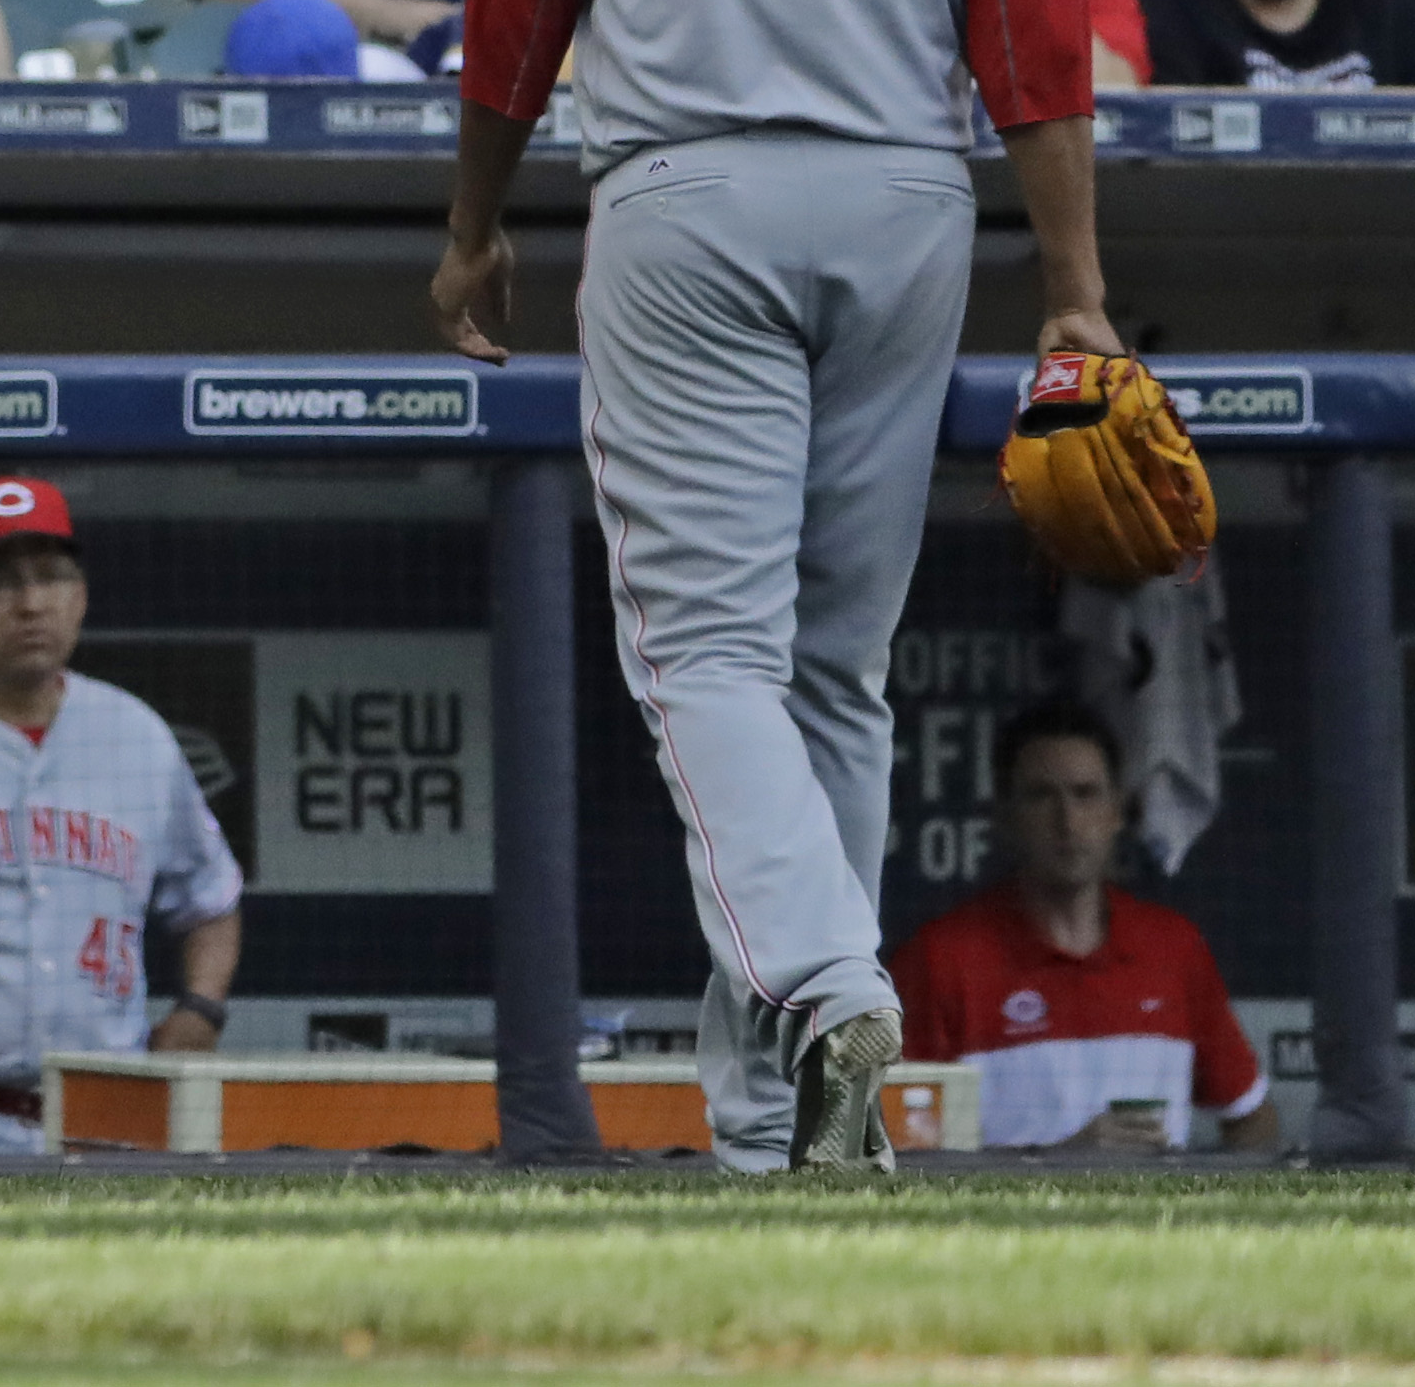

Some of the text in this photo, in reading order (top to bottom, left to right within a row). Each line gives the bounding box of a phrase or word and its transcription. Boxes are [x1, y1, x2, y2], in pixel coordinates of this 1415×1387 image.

[198, 384, 463, 420] brewers.com
[295, 690, 462, 758] NEW
[296, 767, 464, 833] ERA
